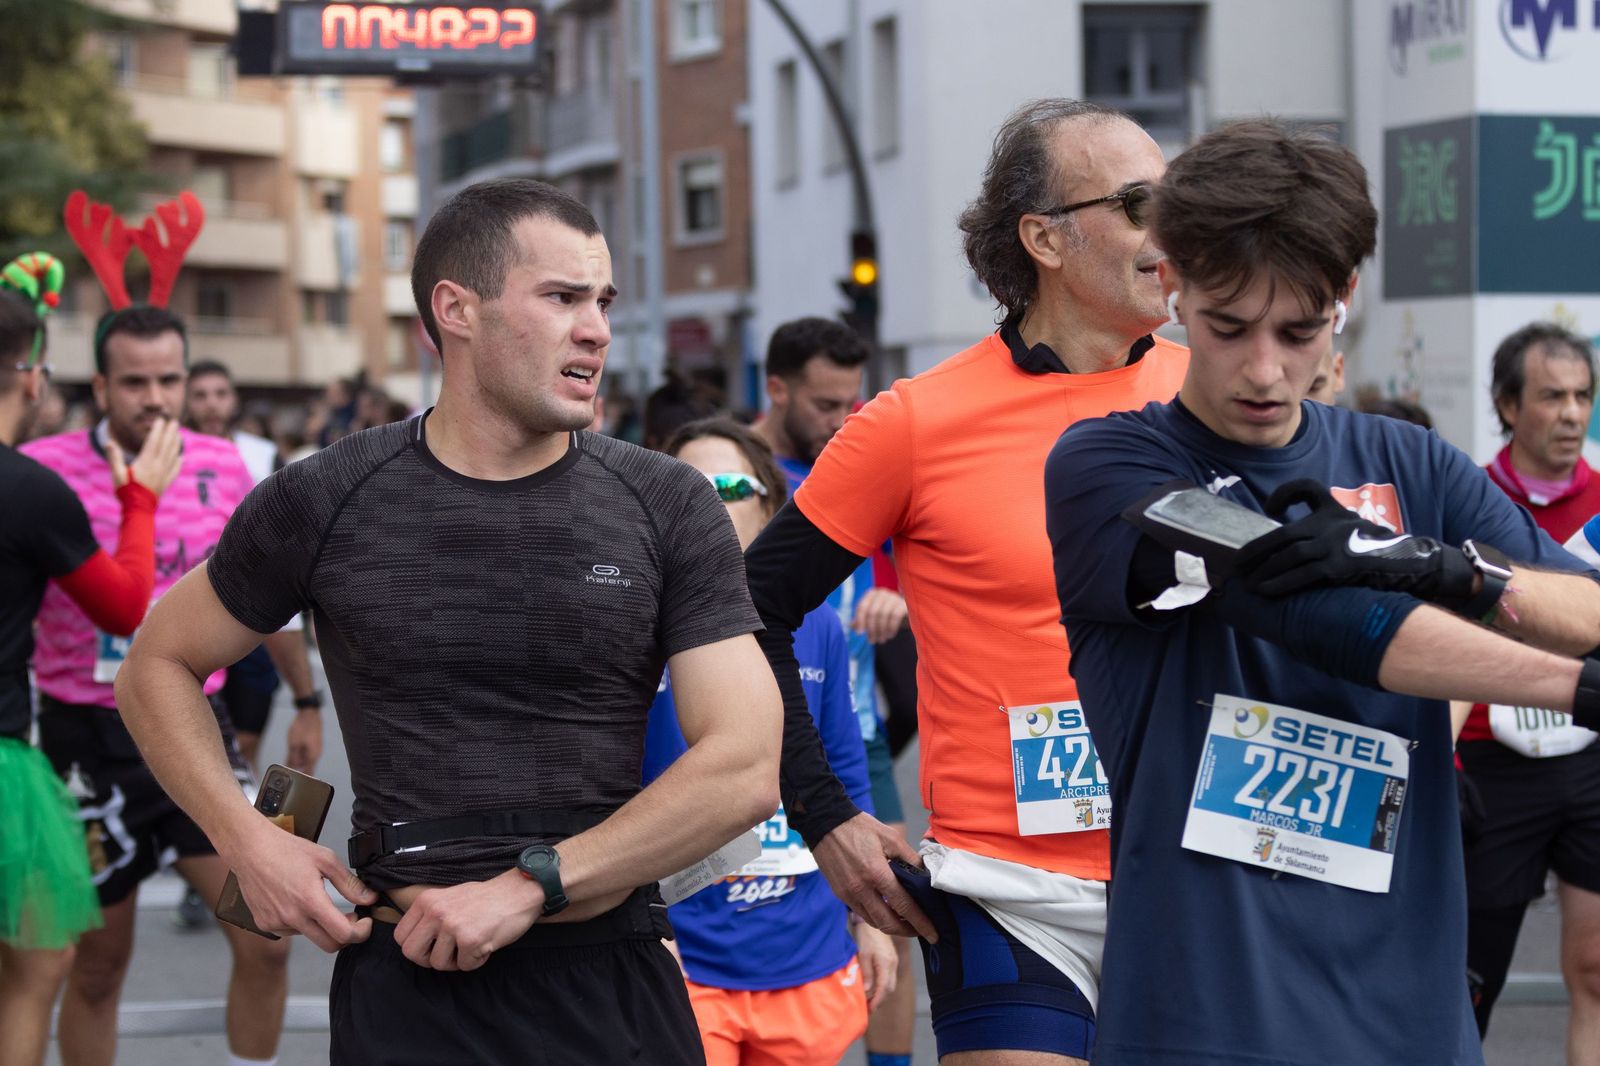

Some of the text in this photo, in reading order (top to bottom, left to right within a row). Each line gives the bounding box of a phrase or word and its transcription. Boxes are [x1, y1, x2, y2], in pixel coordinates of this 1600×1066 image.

[1271, 716, 1394, 768] SETEL
[1234, 744, 1355, 828] 2231
[1250, 809, 1324, 839] MARCOS JR
[1273, 854, 1326, 875] de Salamanca
[1276, 842, 1330, 864] Ayuntamiento
[726, 877, 795, 904] 2022
